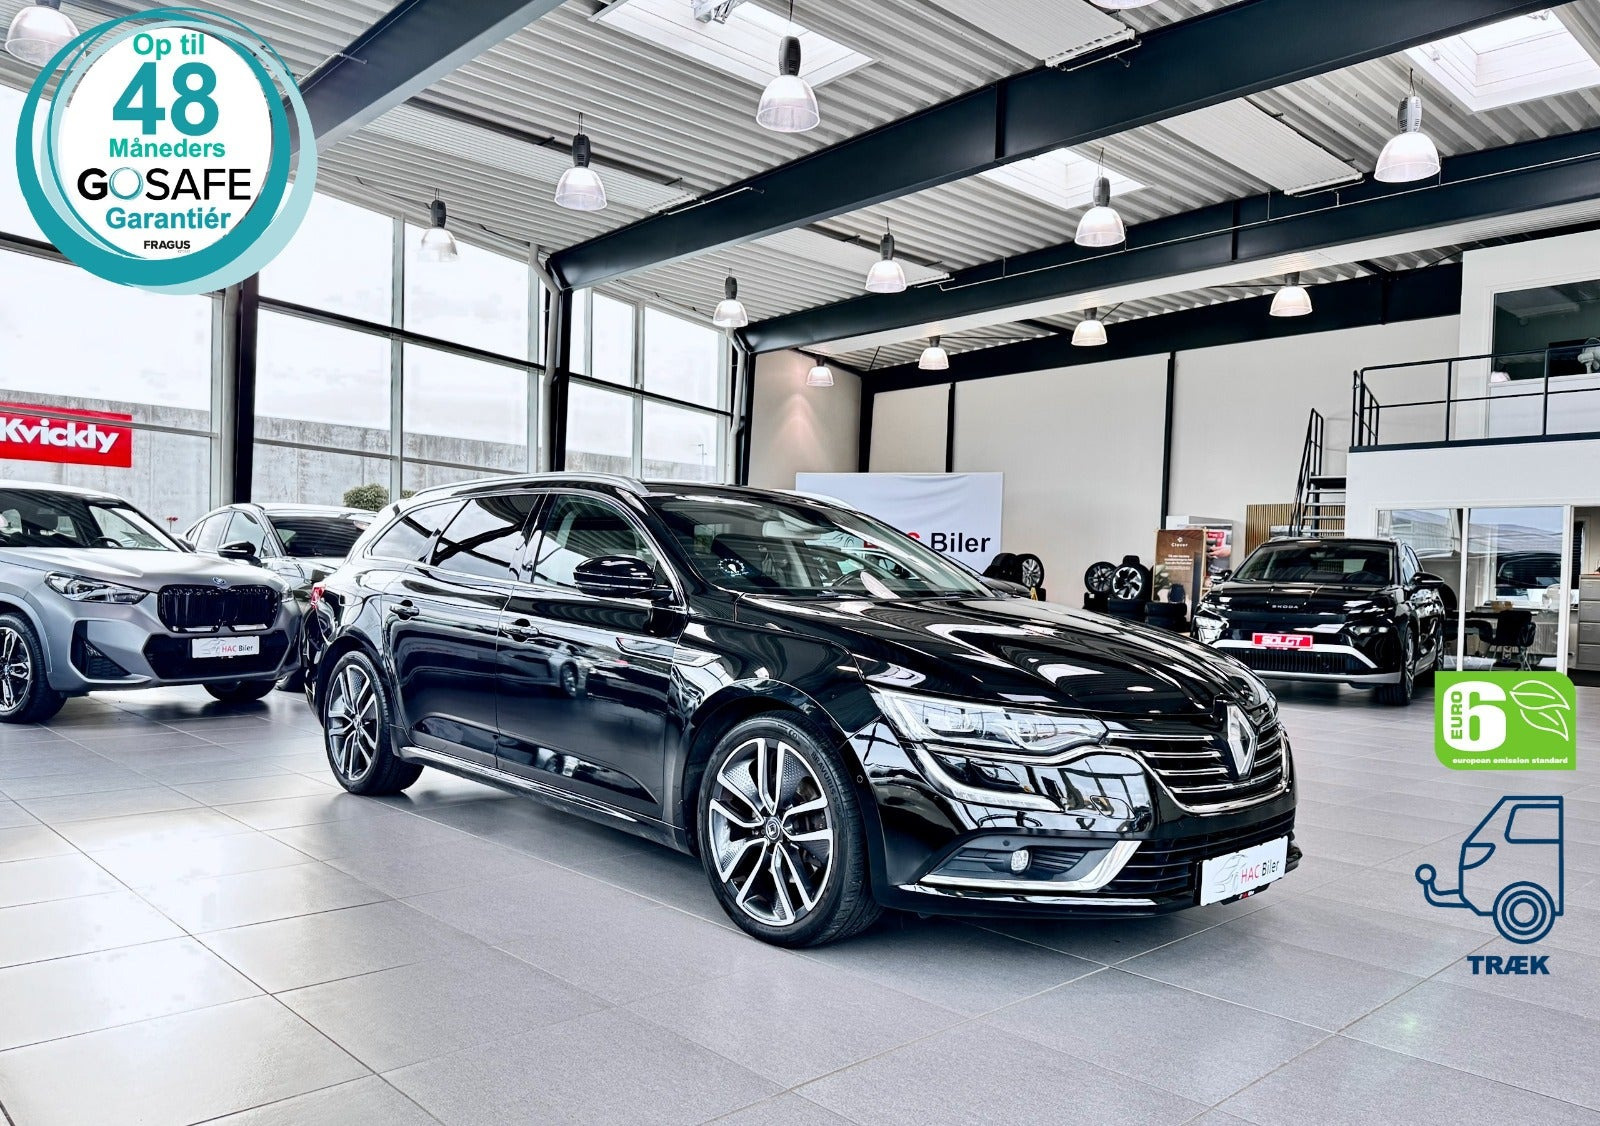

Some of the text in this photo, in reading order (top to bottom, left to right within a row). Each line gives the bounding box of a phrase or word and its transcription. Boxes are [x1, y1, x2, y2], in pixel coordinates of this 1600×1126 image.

[0, 417, 119, 453] Kvickly
[931, 532, 991, 553] Biler
[221, 644, 254, 653] HAC Biler
[1261, 635, 1303, 647] SOLGT
[1240, 859, 1279, 884] HAC Biler
